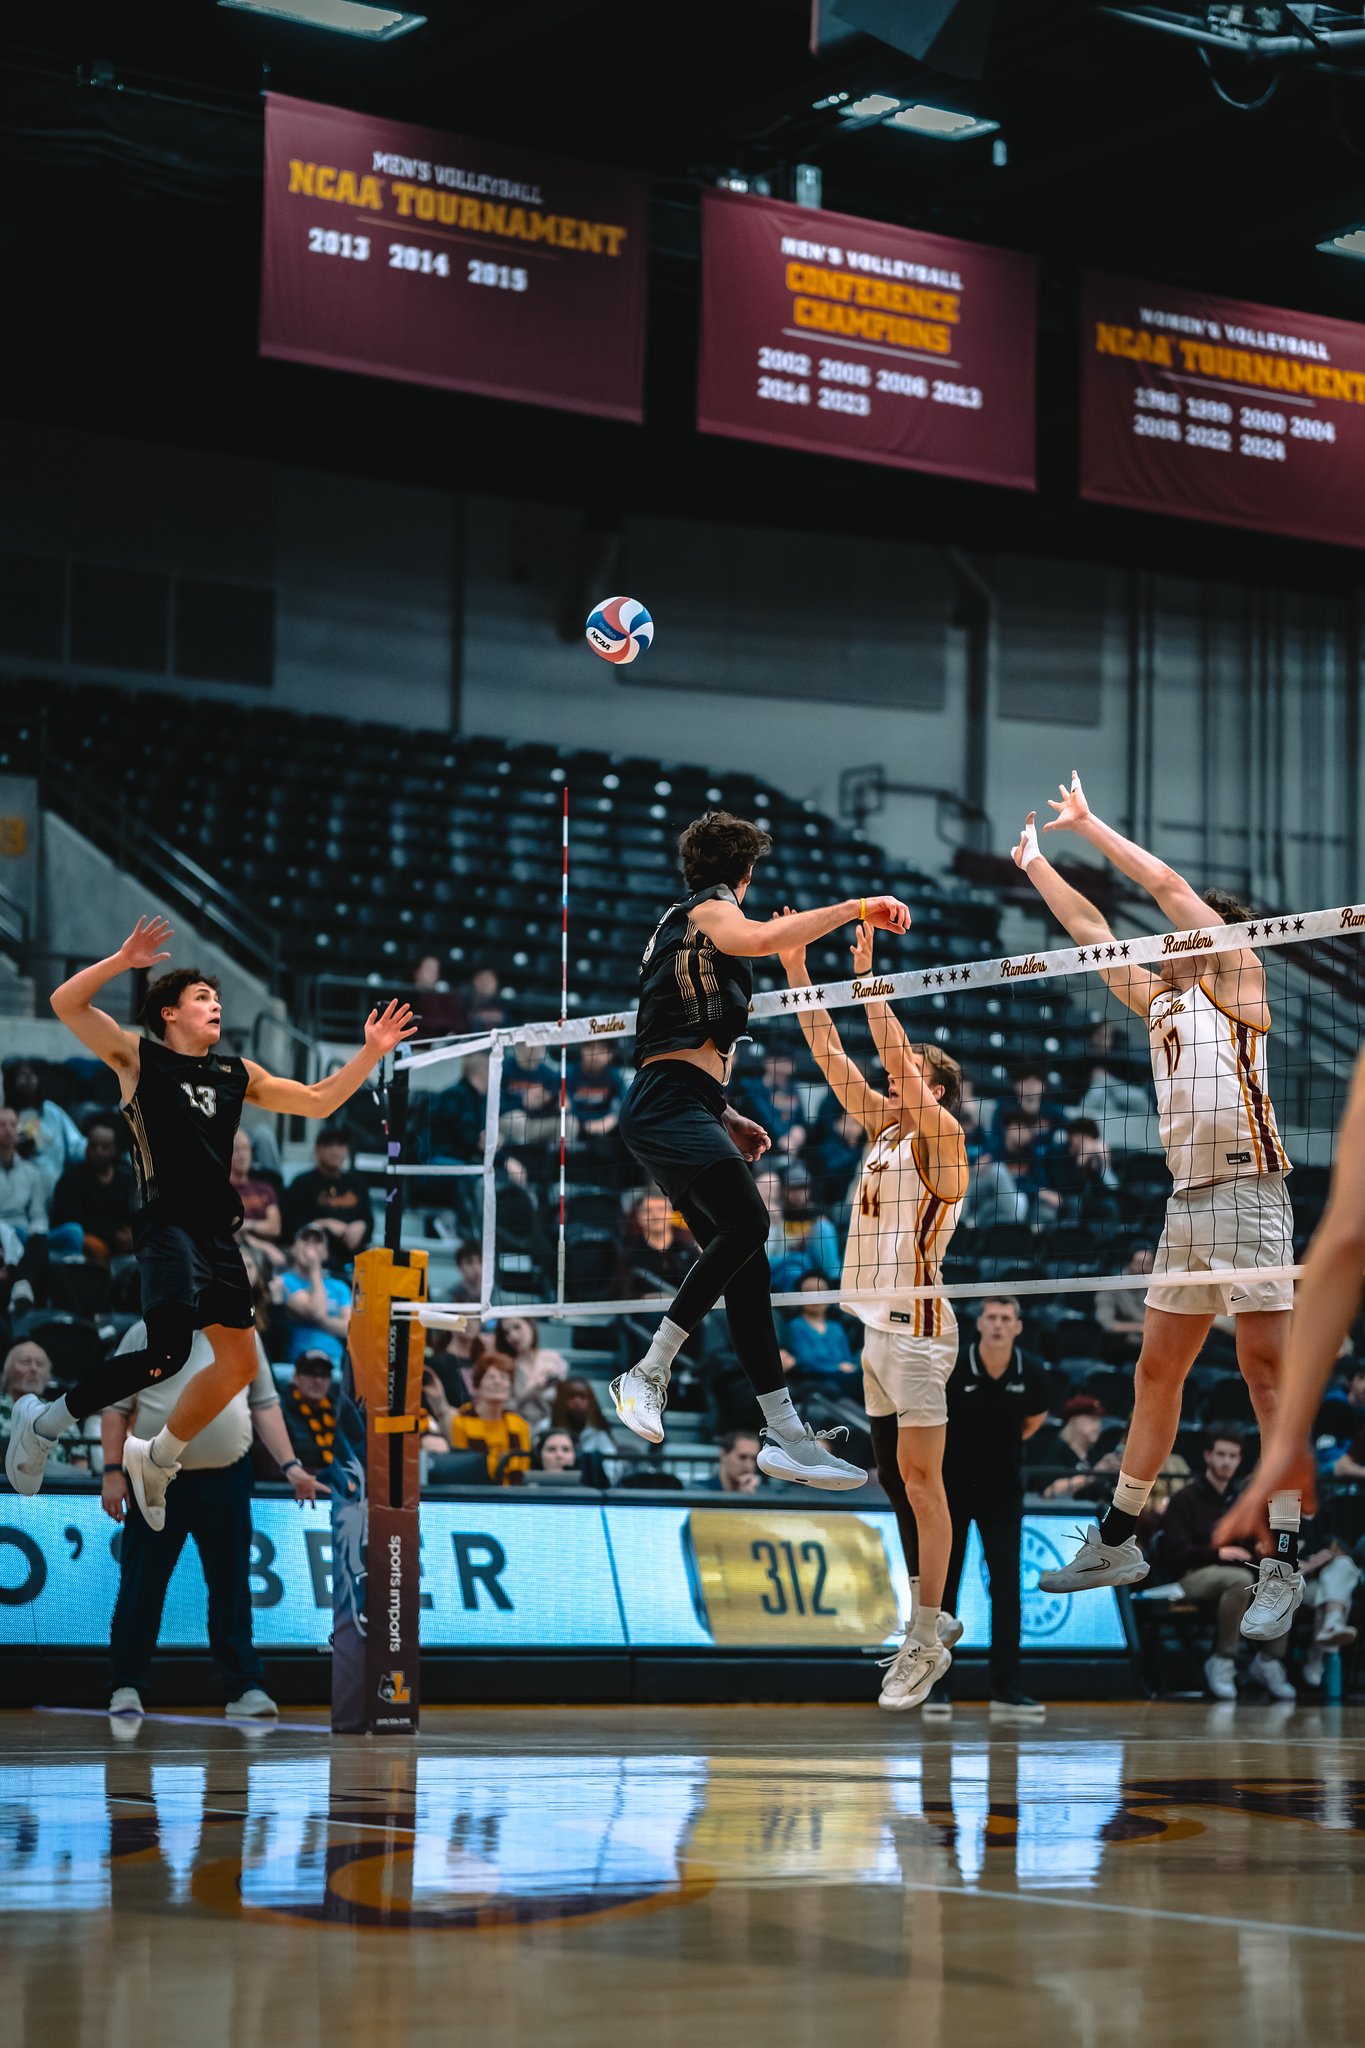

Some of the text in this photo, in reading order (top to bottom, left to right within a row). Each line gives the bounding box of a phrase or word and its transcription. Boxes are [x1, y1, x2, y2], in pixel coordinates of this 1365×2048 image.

[372, 151, 544, 205] MEN'S VOLLEYBALL
[288, 159, 627, 257] NCAA TOURNAMENT
[308, 227, 528, 293] 2013 2014 2015
[781, 236, 964, 290] MEN'S VOLLEYBALL
[785, 261, 961, 324] CONFERENCE
[793, 296, 951, 354] CHAMPIONS
[1139, 307, 1331, 361] WOMEN'S VOLLEYBALL
[758, 346, 811, 377] 2002
[1095, 322, 1365, 405] NCAA TOURNAMENT
[818, 386, 871, 417] 2023
[1240, 406, 1287, 435] 2000
[1290, 415, 1336, 444] 2004
[1185, 424, 1232, 453] 2022
[1240, 433, 1287, 462] 2024
[591, 630, 611, 650] NCAA
[1000, 955, 1048, 978] Ramblers
[1162, 930, 1214, 955] Ramblers
[851, 978, 895, 999] Ramblers
[588, 1015, 626, 1035] Ramblers
[1163, 1026, 1181, 1078] 17
[180, 1082, 217, 1118] 13
[251, 1529, 514, 1612] BER
[388, 1535, 401, 1652] sports imports
[751, 1540, 838, 1617] 312
